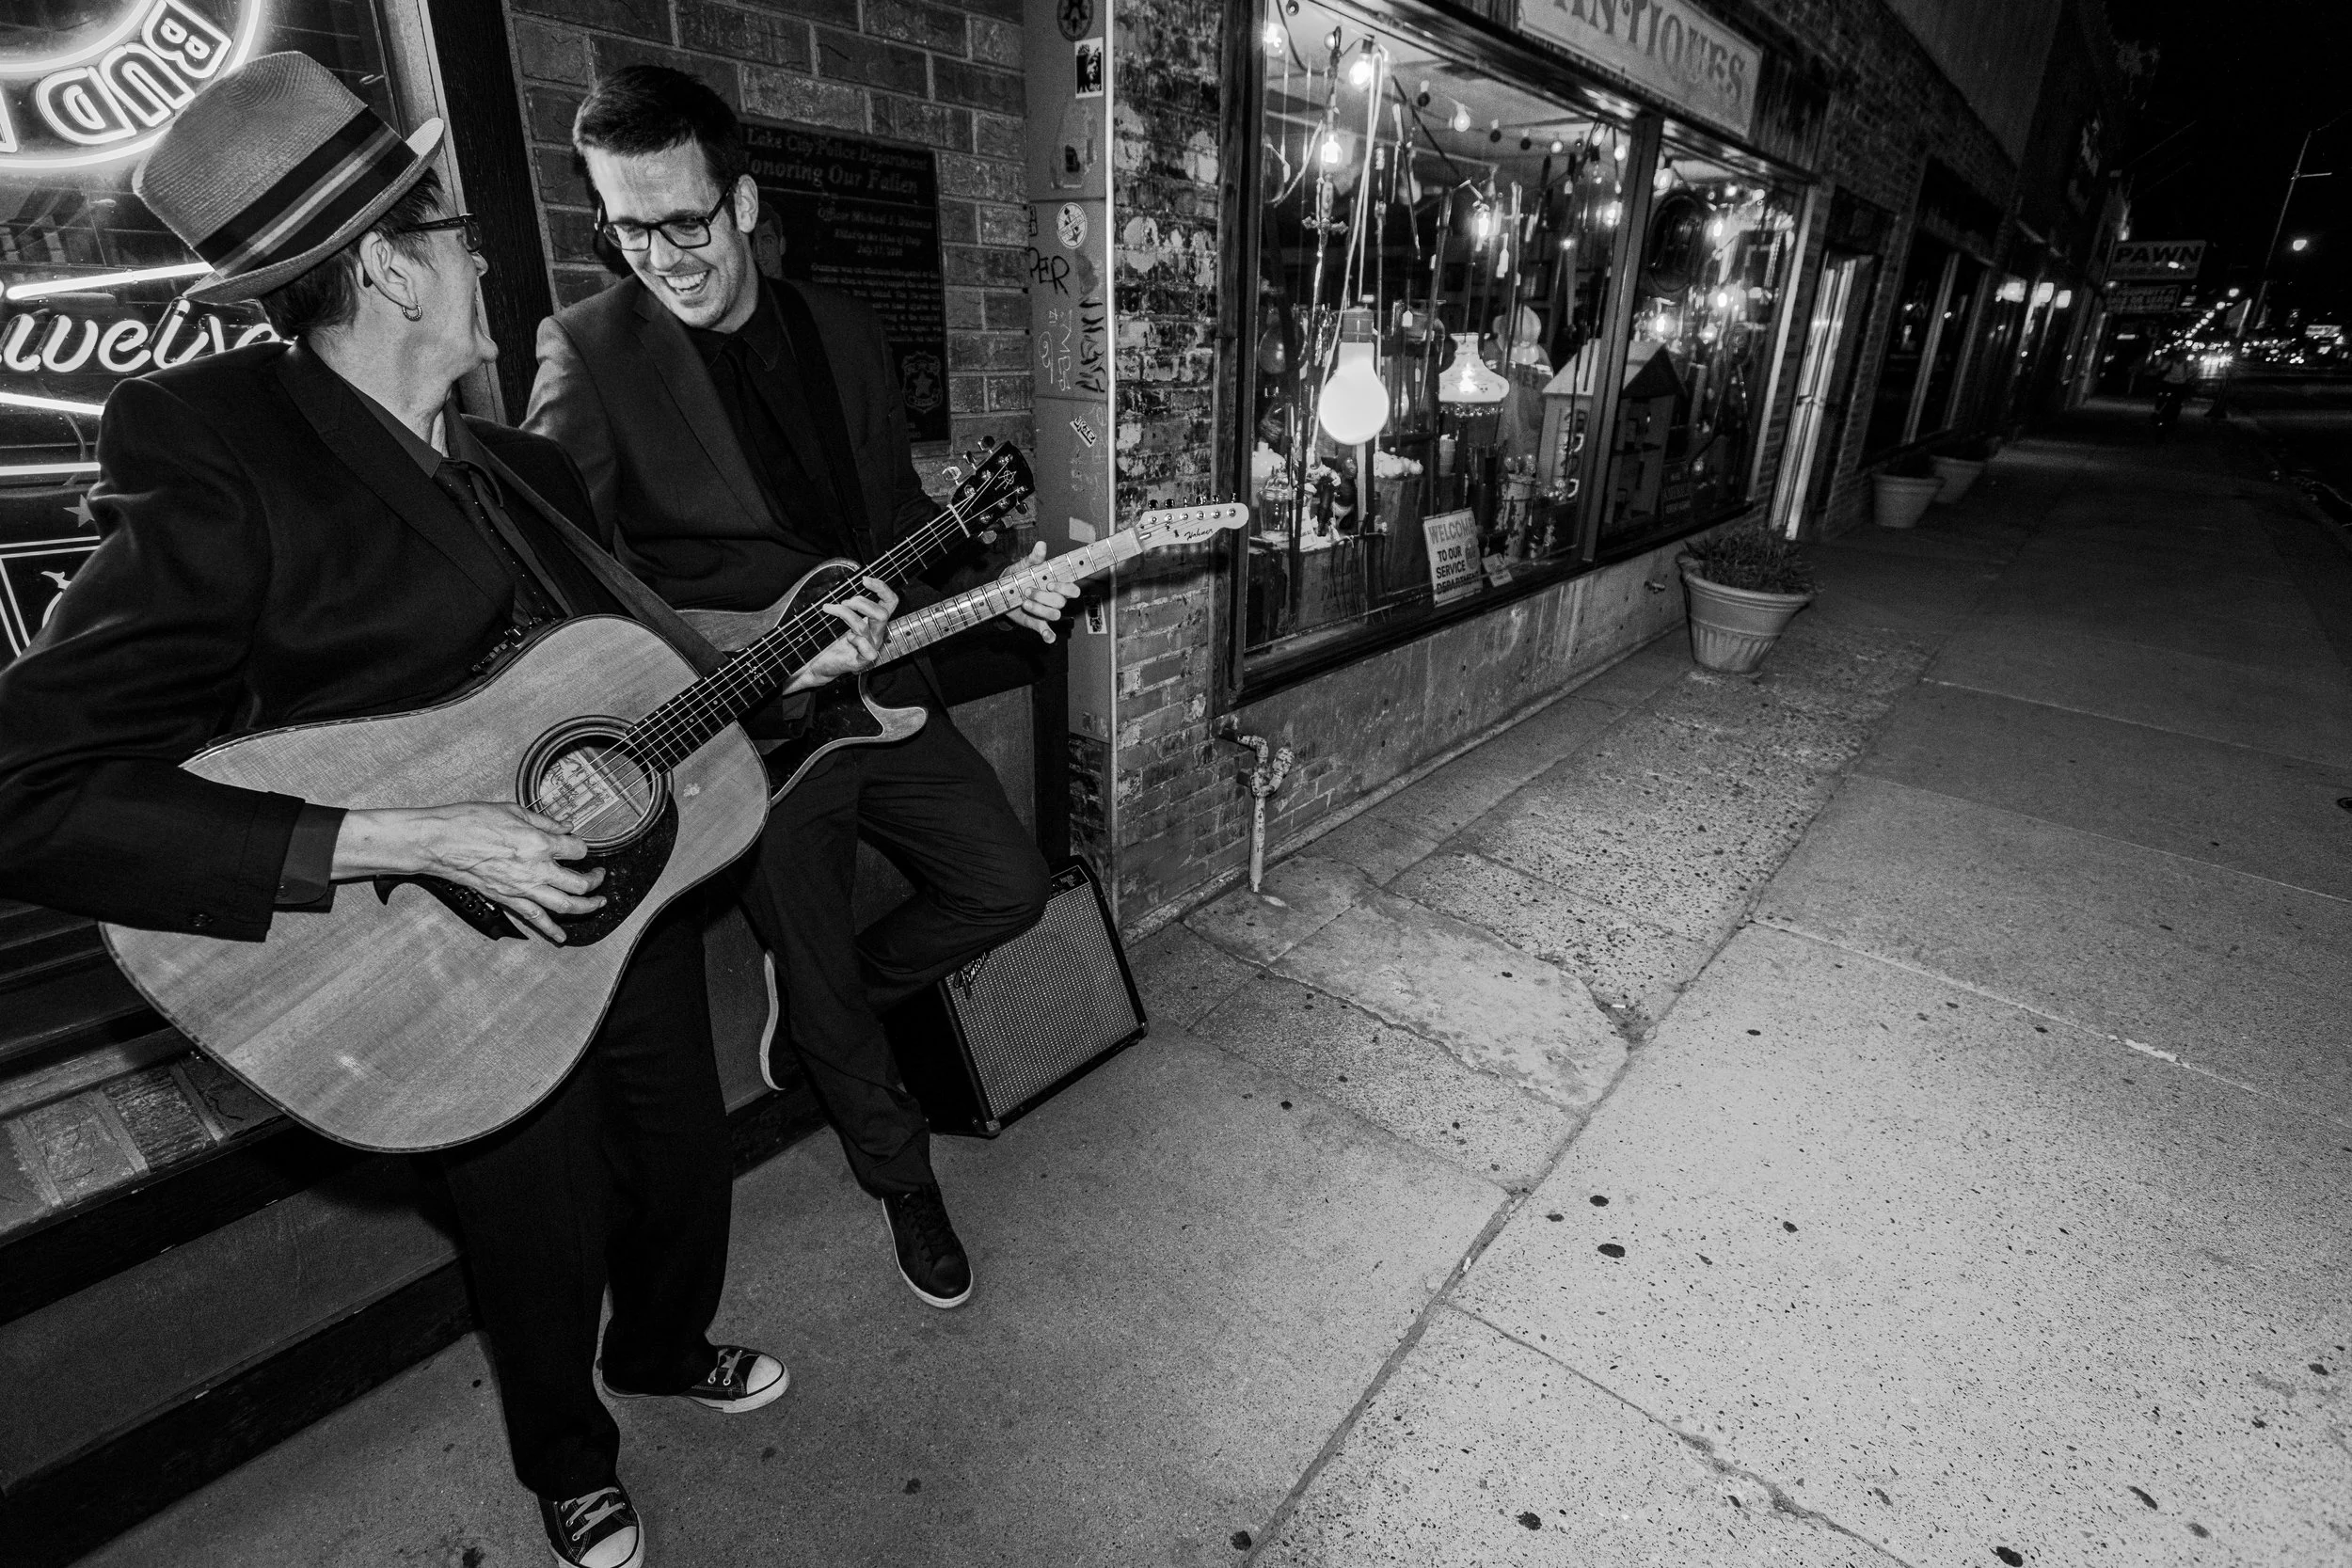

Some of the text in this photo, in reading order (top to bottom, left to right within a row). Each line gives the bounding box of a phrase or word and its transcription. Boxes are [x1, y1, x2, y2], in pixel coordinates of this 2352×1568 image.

[1553, 0, 1745, 104] NTIQUES
[0, 0, 232, 153] BUD
[815, 137, 857, 160] Police
[828, 164, 863, 187] Our
[867, 168, 918, 195] Fallen
[2115, 245, 2201, 262] PAWN
[1428, 517, 1476, 545] WELCOME
[1438, 546, 1463, 562] TO OUR
[1436, 560, 1466, 578] SERVICE
